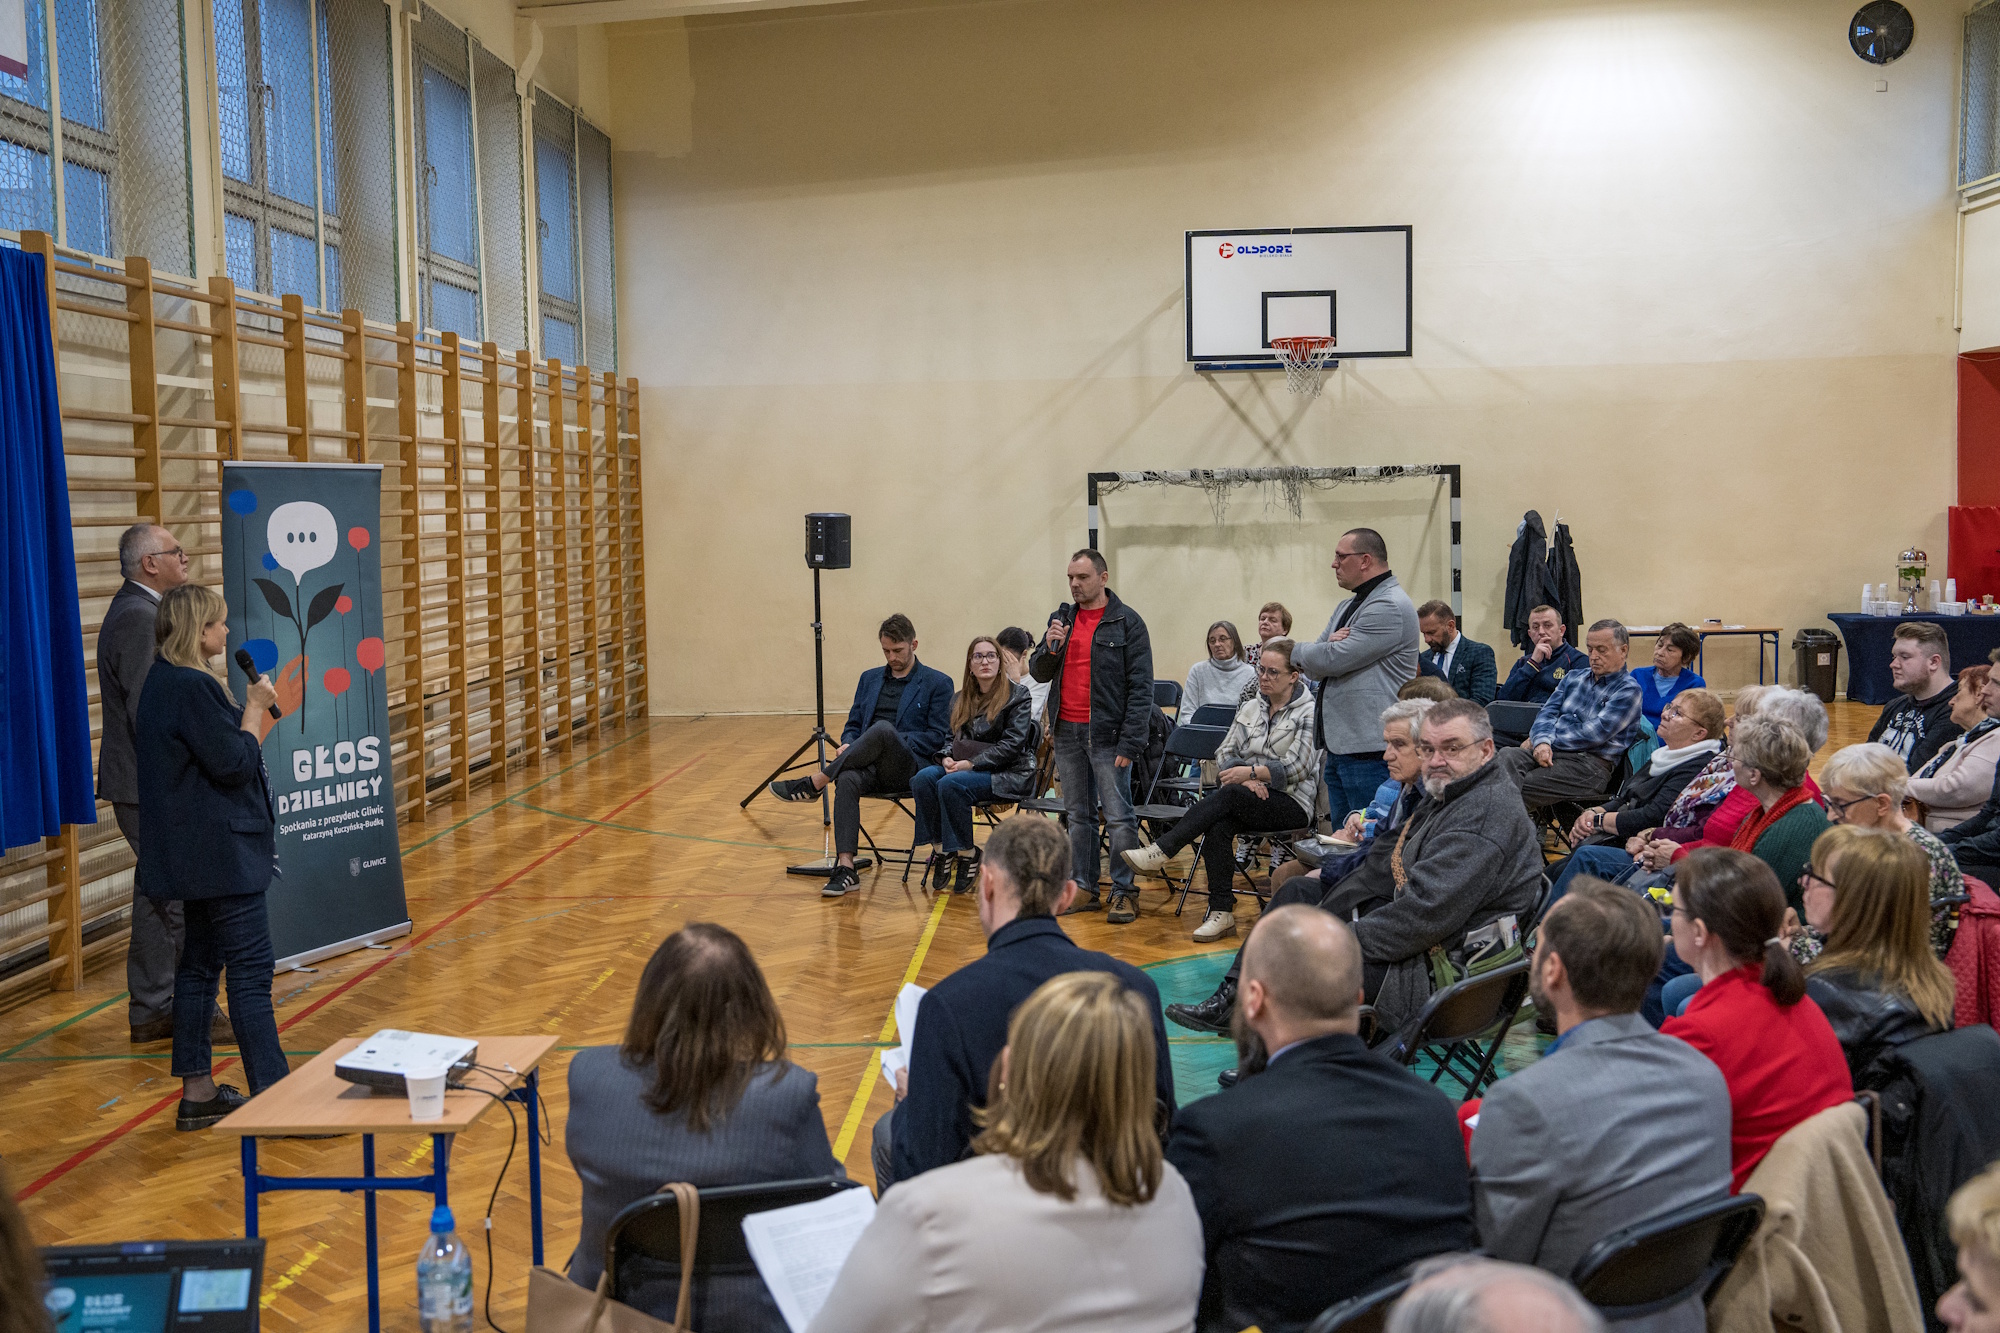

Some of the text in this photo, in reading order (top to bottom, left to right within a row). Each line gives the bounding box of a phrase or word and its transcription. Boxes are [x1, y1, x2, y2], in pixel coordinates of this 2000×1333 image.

[293, 736, 380, 782] GŁOS
[278, 775, 382, 815] DZIELNICY
[280, 805, 384, 835] Spotkania z prezydent Gliwic
[303, 818, 384, 841] Katarzyną Kuczyńską-Budką
[362, 857, 387, 868] GLIWICE
